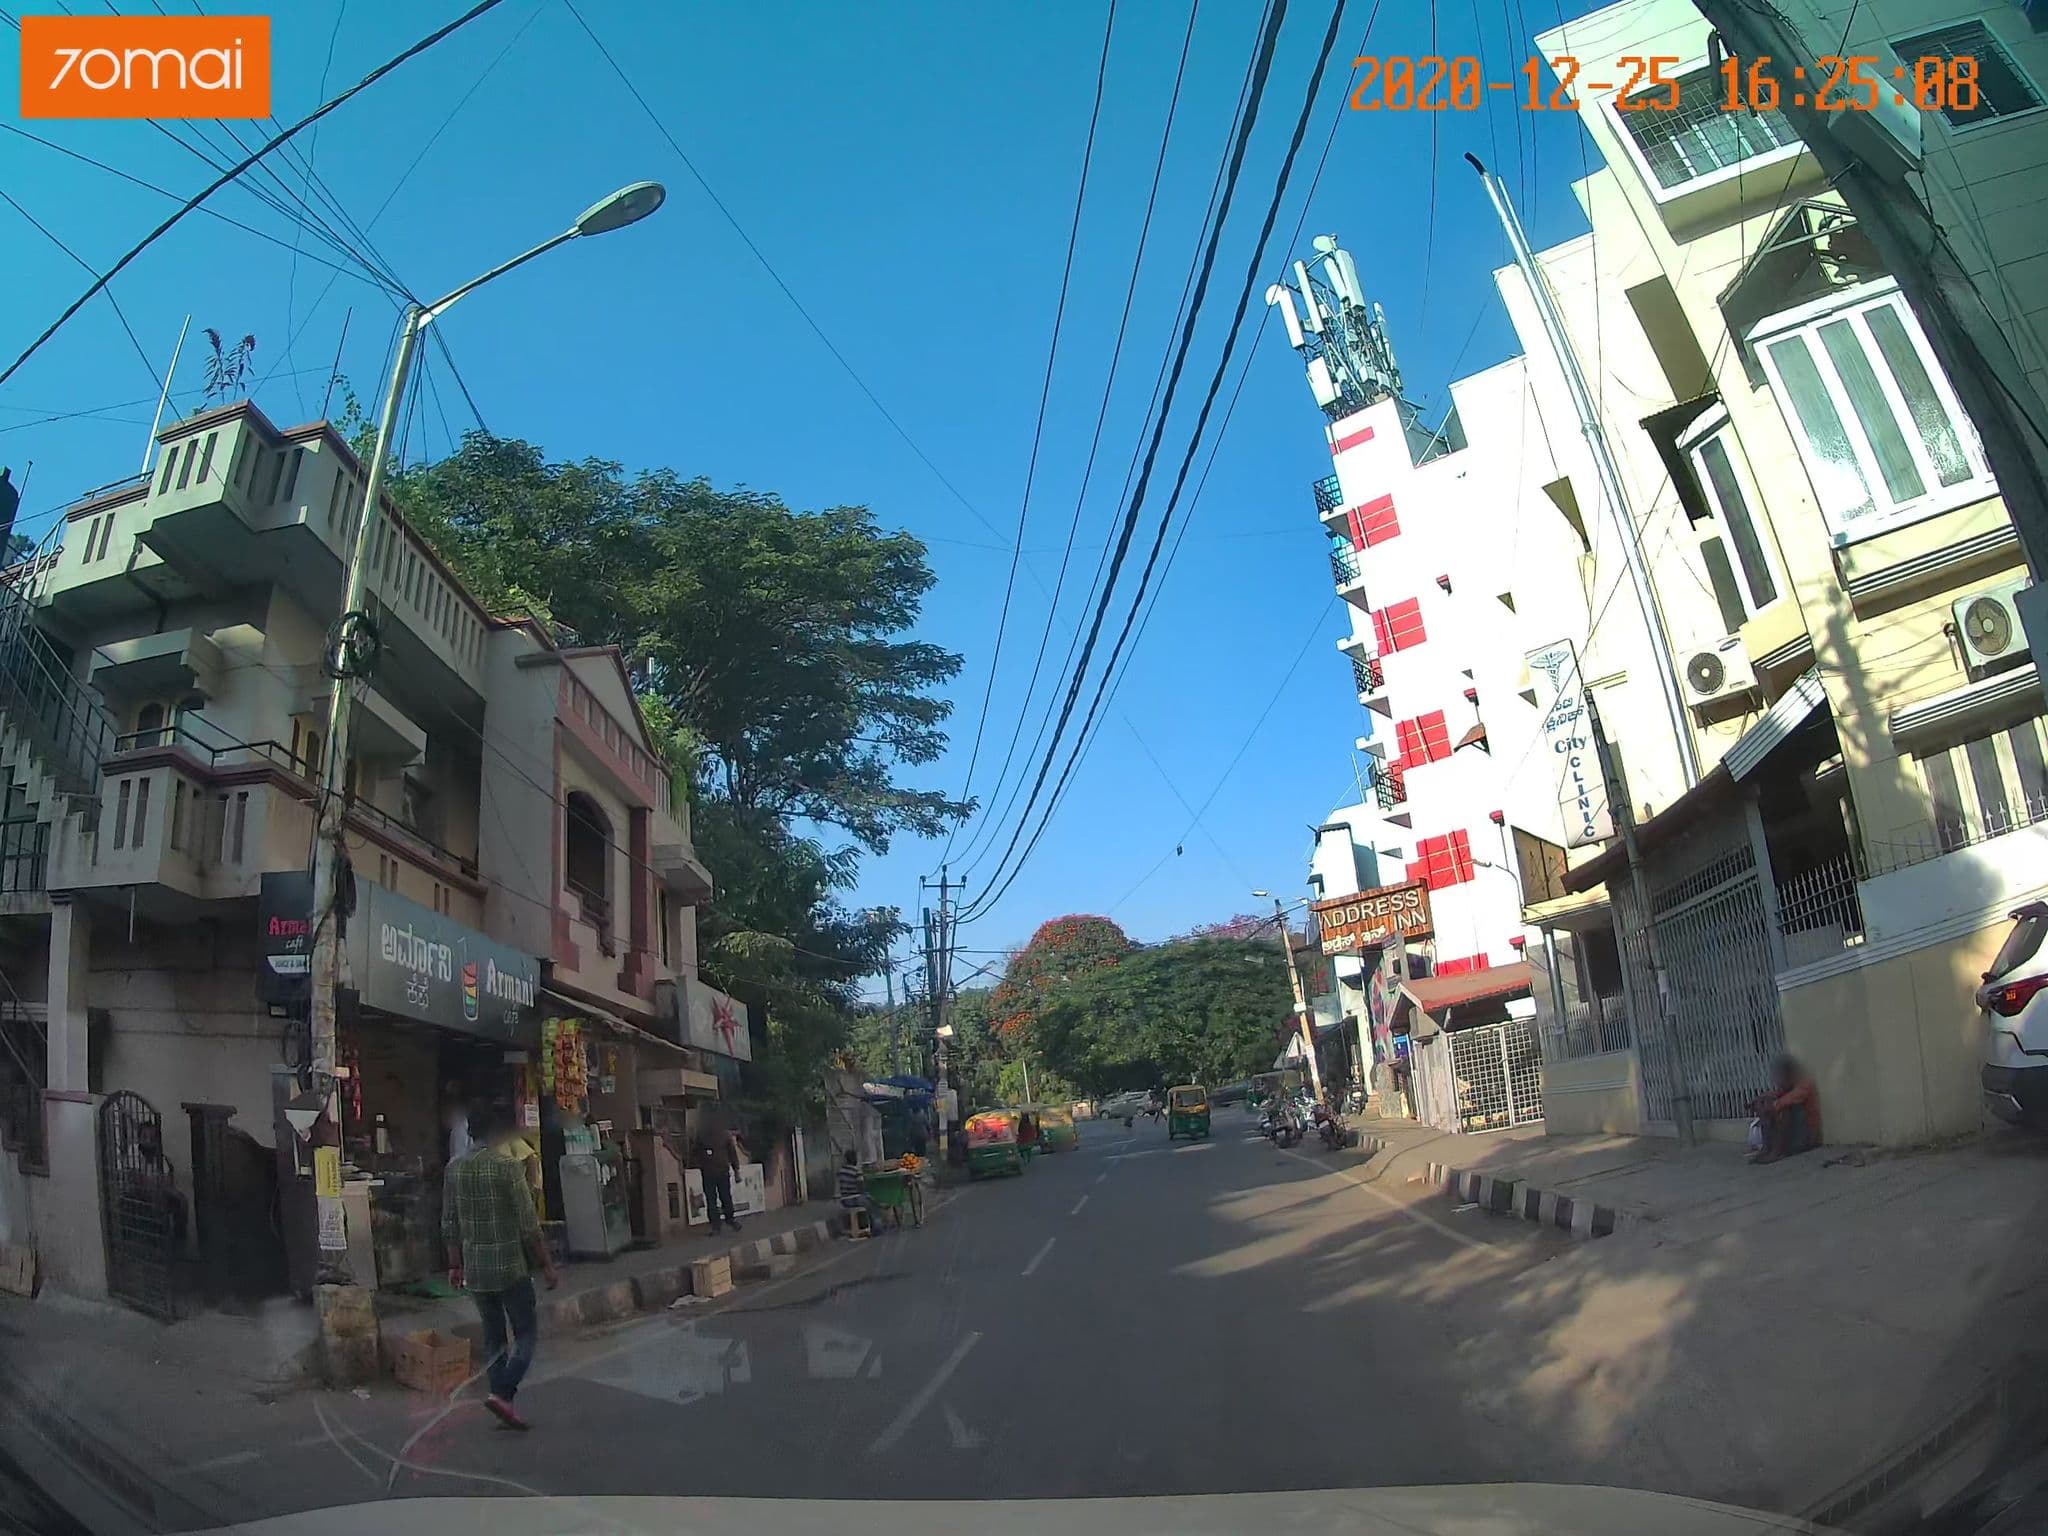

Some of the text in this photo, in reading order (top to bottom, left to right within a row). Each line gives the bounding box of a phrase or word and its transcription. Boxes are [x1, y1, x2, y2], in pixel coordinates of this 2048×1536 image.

[1554, 736, 1587, 754] City
[1570, 756, 1596, 837] CLINIC
[1320, 890, 1419, 929] ADDRESS
[1394, 909, 1426, 931] INN
[487, 957, 535, 1008] Armani
